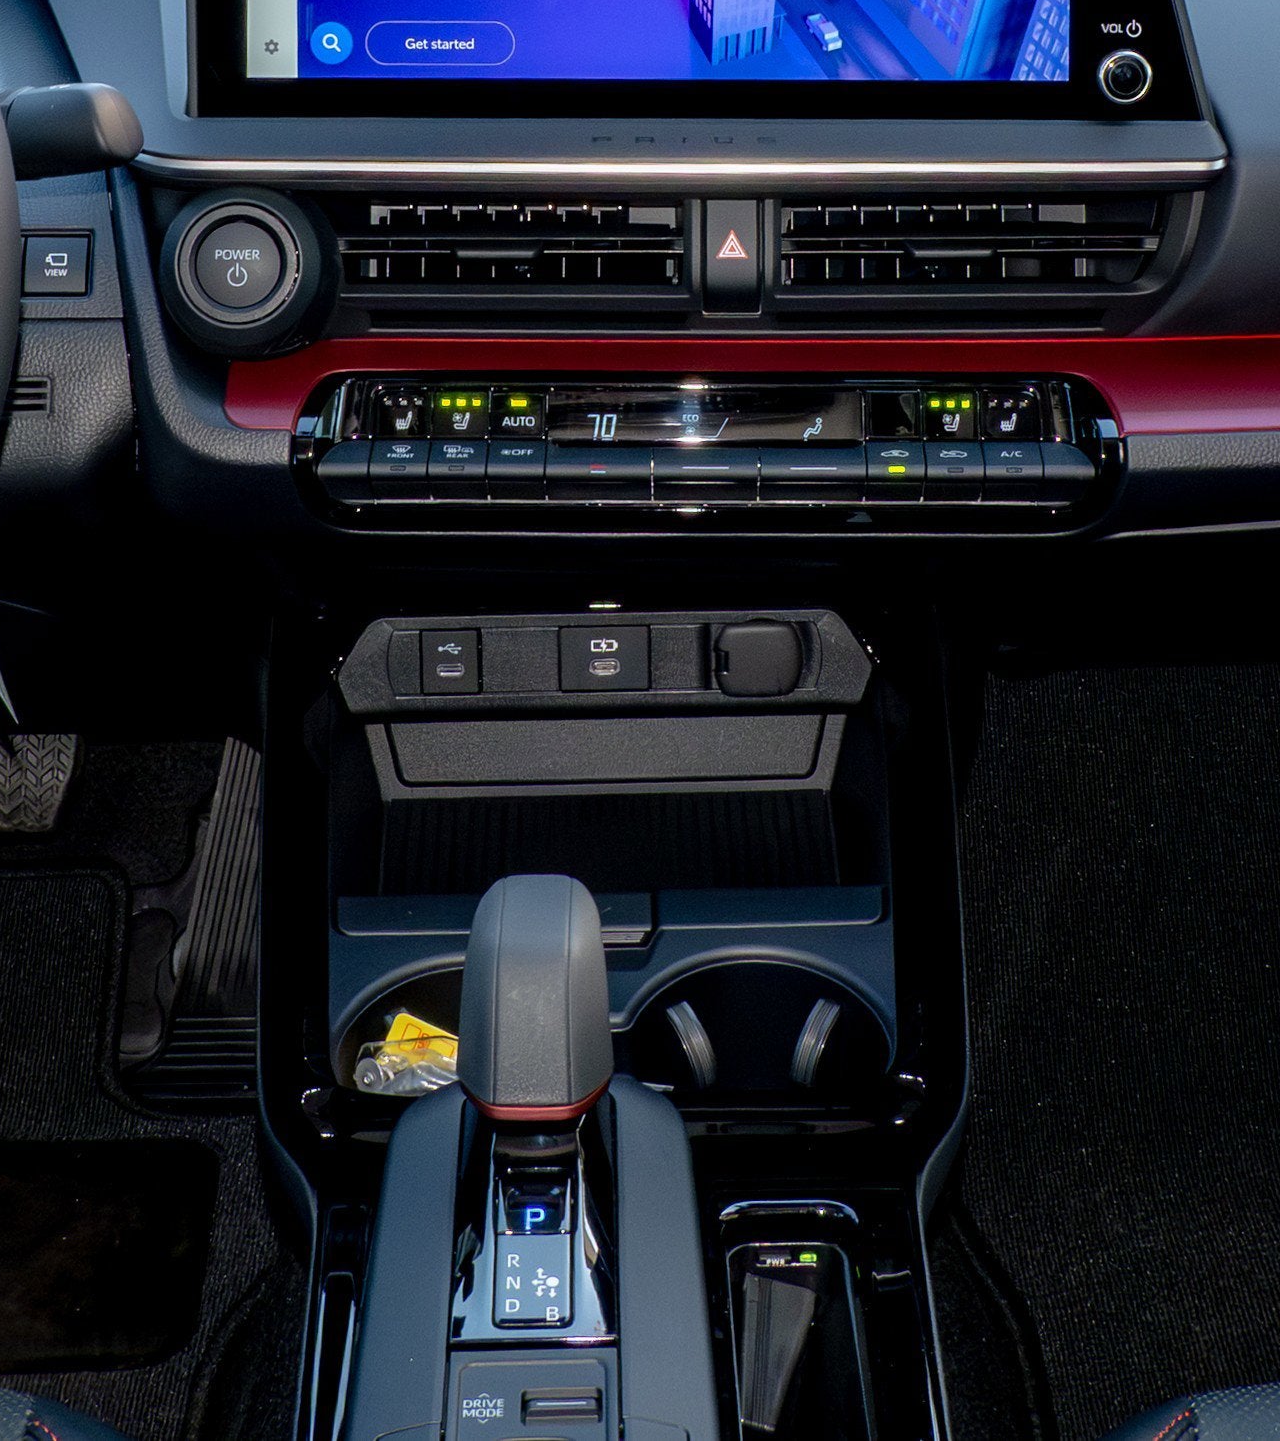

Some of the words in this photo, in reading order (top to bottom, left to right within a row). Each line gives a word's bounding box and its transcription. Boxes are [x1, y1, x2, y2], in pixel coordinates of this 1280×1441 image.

[1101, 23, 1123, 34] VOL
[405, 38, 429, 50] Get
[431, 38, 475, 50] started
[214, 249, 260, 261] POWER
[44, 268, 68, 277] VIEW
[501, 416, 536, 427] AUTO
[681, 413, 700, 423] ECO
[1000, 450, 1023, 458] A/C
[524, 1208, 546, 1231] P
[507, 1253, 520, 1268] R
[506, 1276, 521, 1290] N
[505, 1299, 520, 1313] D
[546, 1307, 560, 1322] B
[463, 1399, 505, 1408] DRIVE
[462, 1408, 505, 1418] MODE
